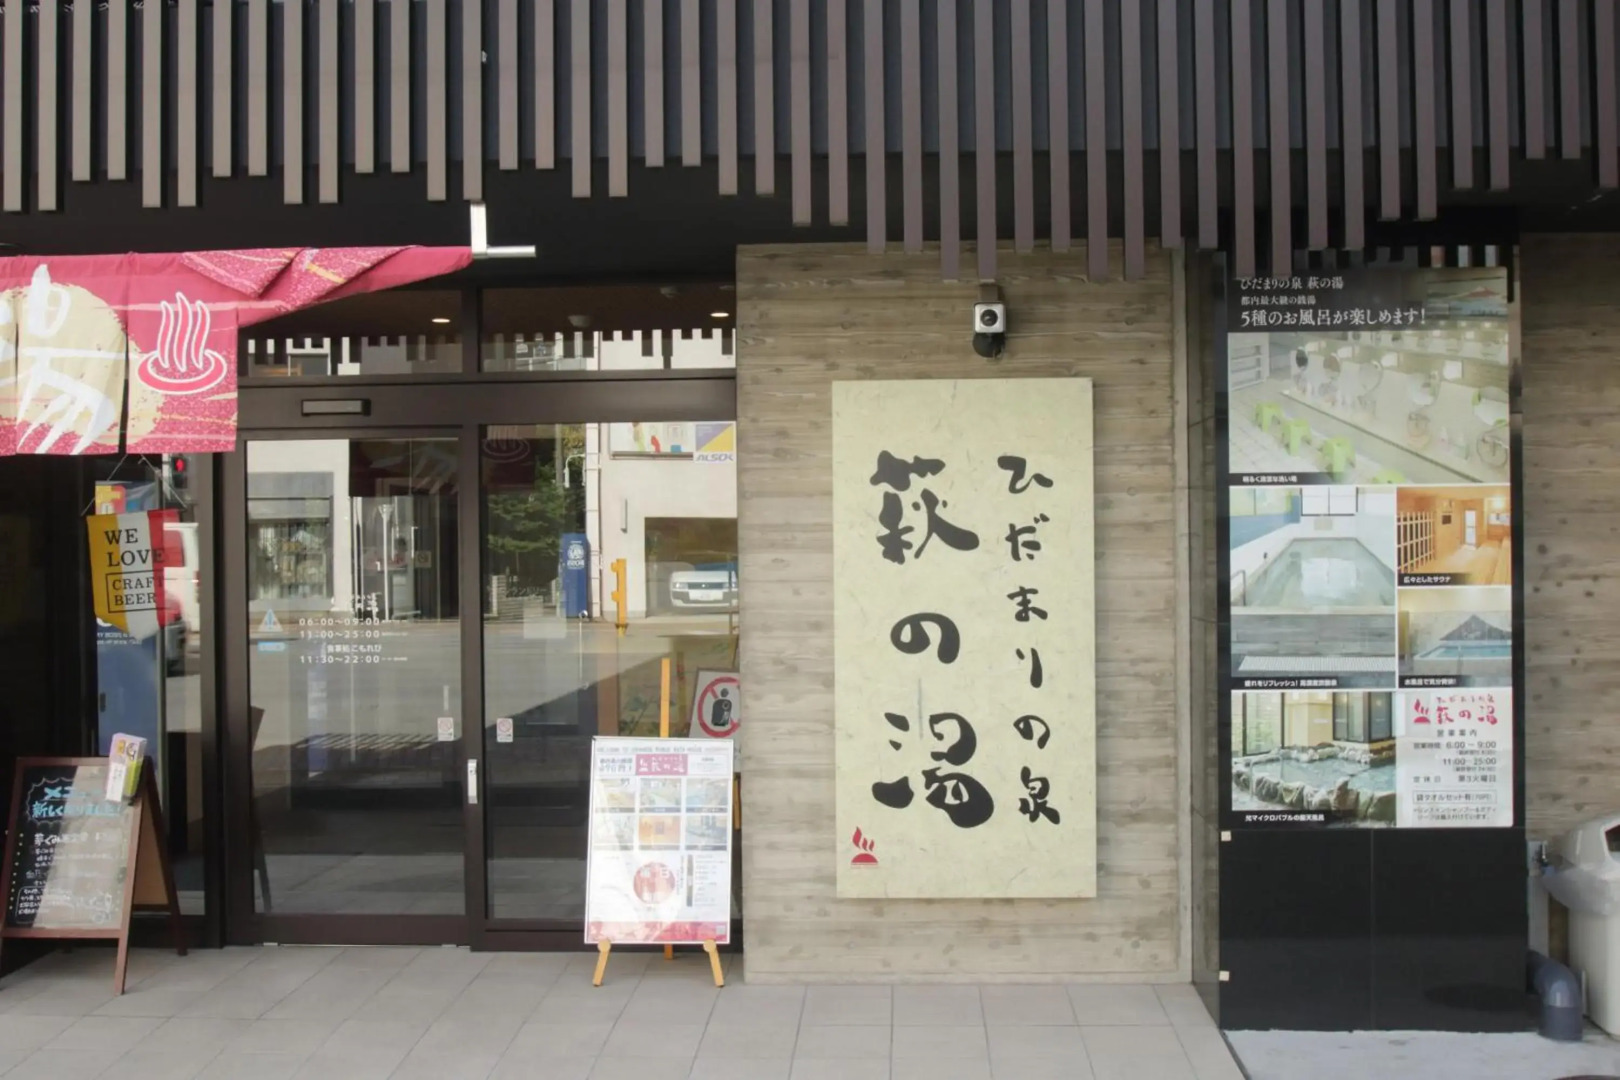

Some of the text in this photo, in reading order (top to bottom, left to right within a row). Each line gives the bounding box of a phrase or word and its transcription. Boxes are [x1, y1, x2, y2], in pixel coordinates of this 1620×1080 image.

[1240, 276, 1344, 290] ひだまりの泉 萩の湯
[1240, 308, 1426, 327] 5種のお風呂が楽しめます!
[104, 528, 139, 545] WE
[107, 549, 165, 568] LOVE
[112, 577, 164, 591] CRAFT
[115, 592, 157, 606] BEER
[869, 450, 994, 828] 萩の湯
[997, 455, 1061, 826] ひだまりの泉
[1436, 705, 1498, 725] 萩の湯
